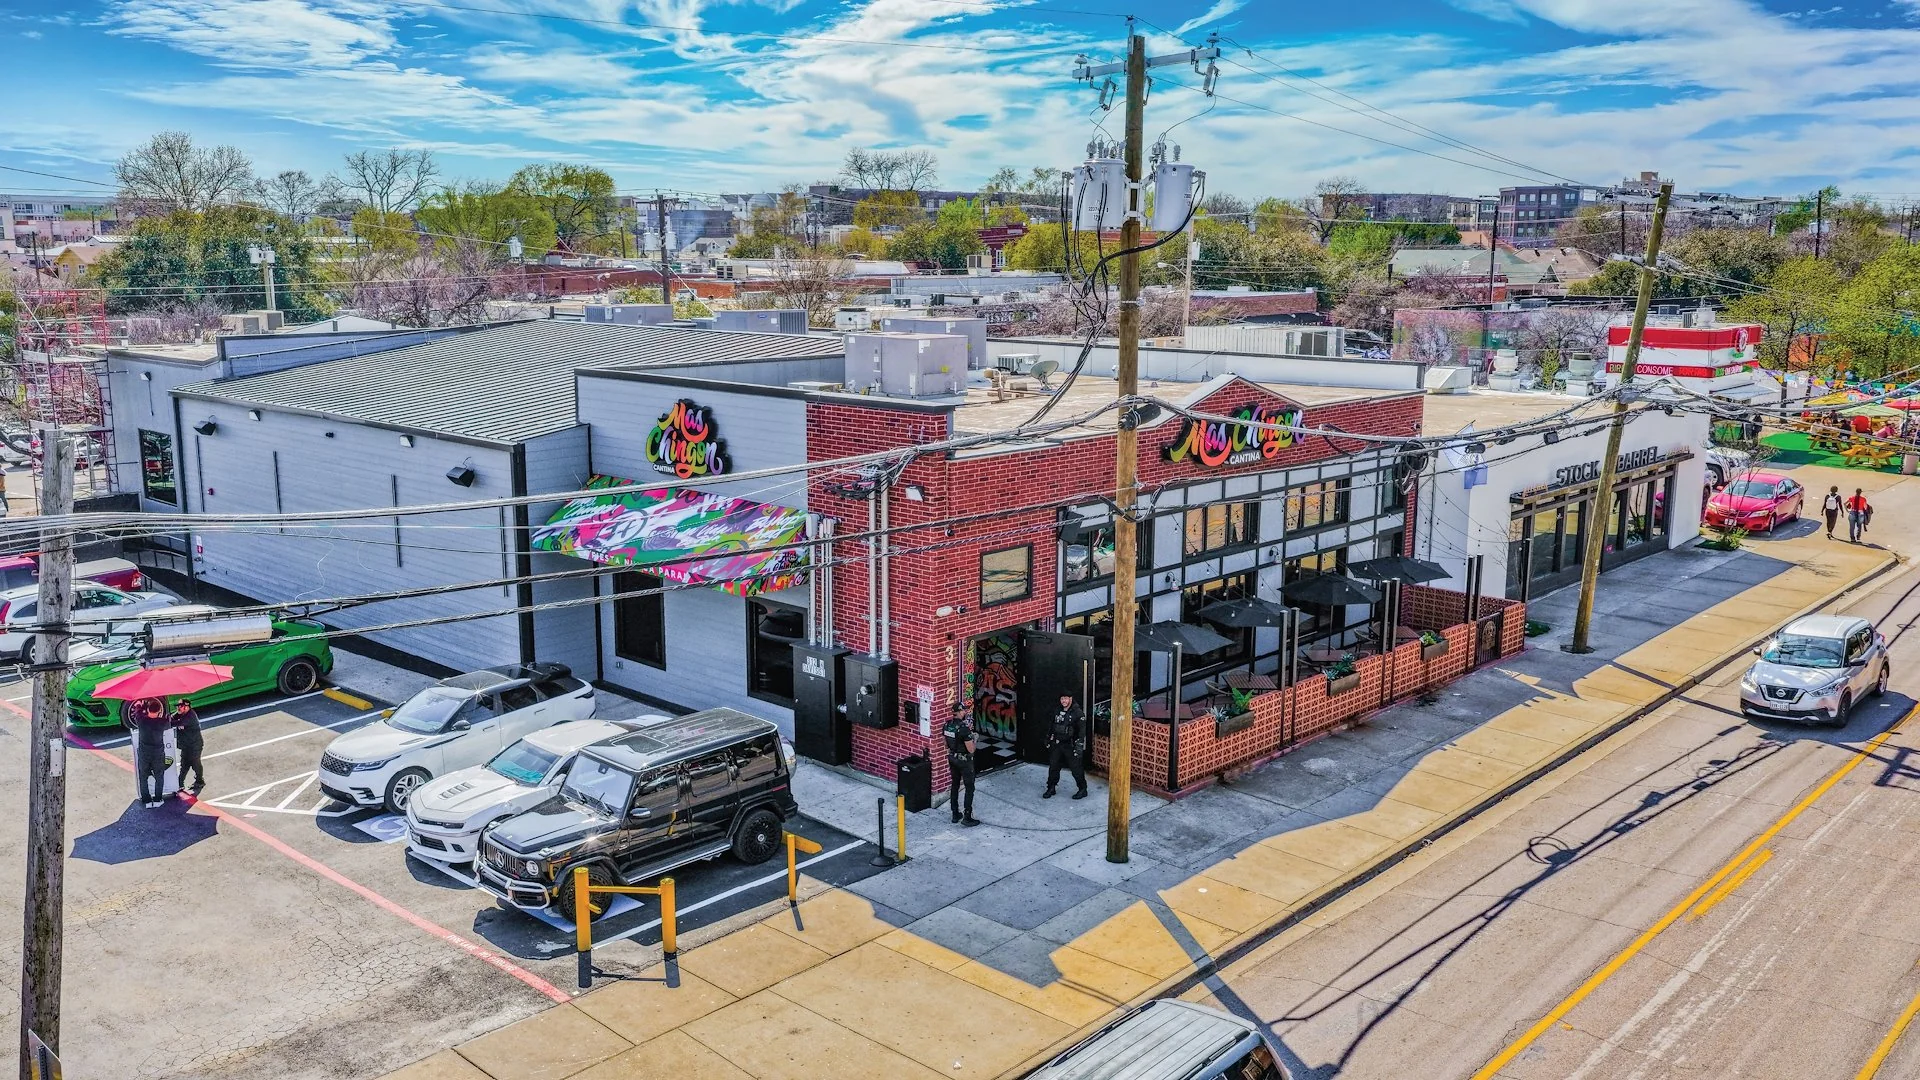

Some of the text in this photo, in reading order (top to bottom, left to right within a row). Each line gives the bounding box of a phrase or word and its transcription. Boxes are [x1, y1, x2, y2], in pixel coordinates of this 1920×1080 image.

[1637, 365, 1673, 375] CONSOME
[658, 402, 708, 443] Mas
[1170, 405, 1306, 467] Mas Chingon
[645, 426, 723, 479] Chingon
[653, 464, 675, 474] CANTINA
[1229, 450, 1261, 465] CANTINA
[1556, 460, 1601, 487] STOCK
[1617, 446, 1660, 471] BARREL
